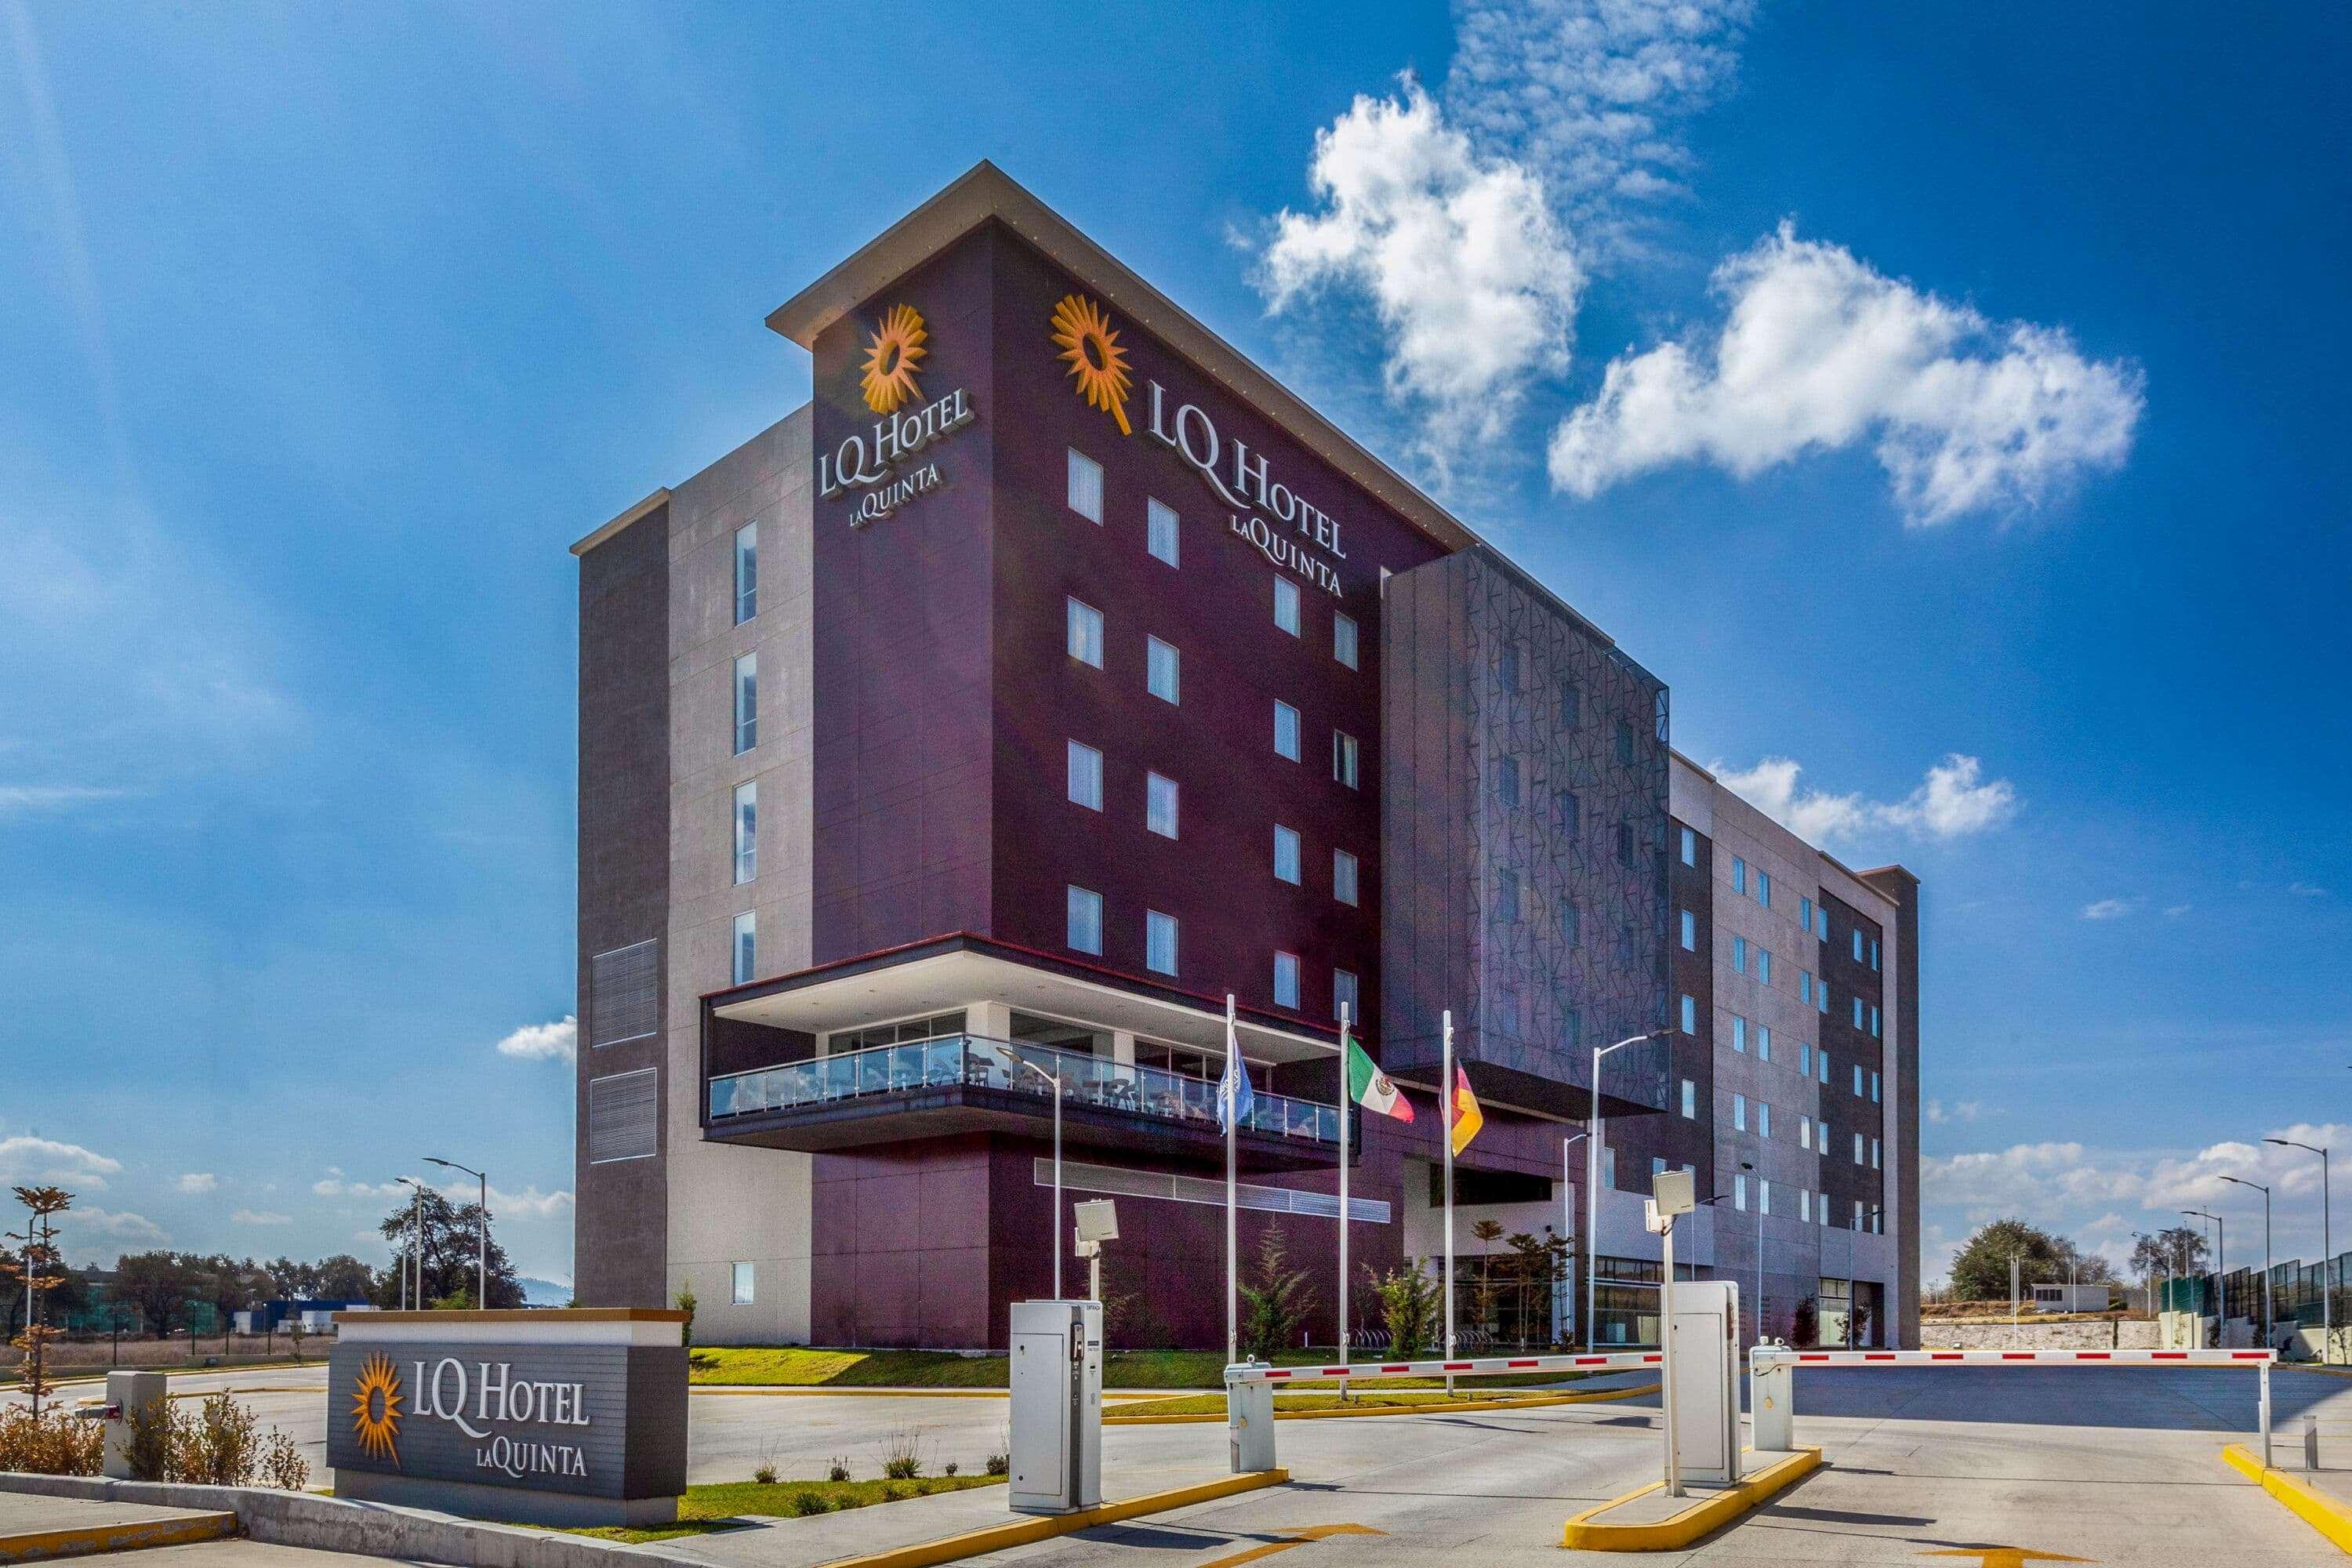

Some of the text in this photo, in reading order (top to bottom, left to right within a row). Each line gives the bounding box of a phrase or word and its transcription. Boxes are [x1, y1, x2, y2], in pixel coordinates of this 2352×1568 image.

[819, 389, 970, 496] LQ HOTEL
[1149, 379, 1347, 559] LQ HOTEL
[413, 1357, 591, 1439] LQ HOTEL
